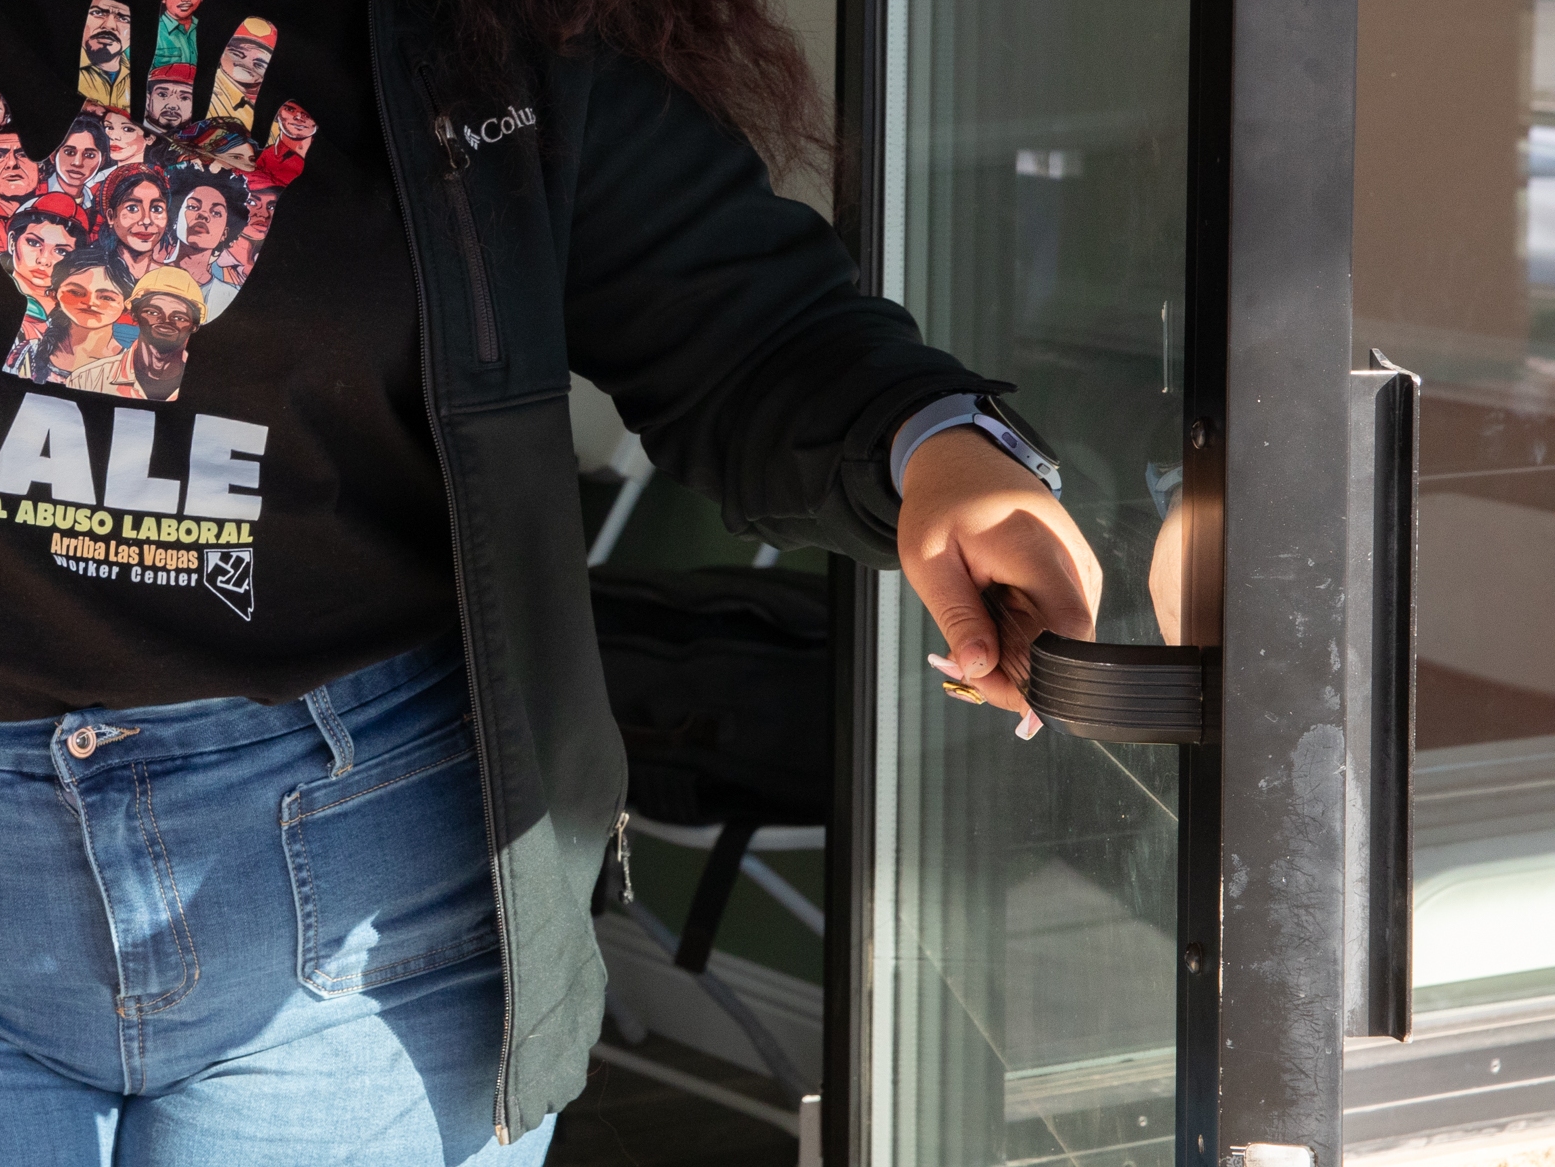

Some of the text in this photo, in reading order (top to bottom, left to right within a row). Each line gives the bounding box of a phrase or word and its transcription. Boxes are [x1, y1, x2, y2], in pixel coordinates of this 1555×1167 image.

[14, 499, 115, 536] ABUSO
[121, 514, 255, 545] LABORAL
[49, 532, 200, 571] Arriba Las Vegas
[51, 554, 200, 588] Worker Center
